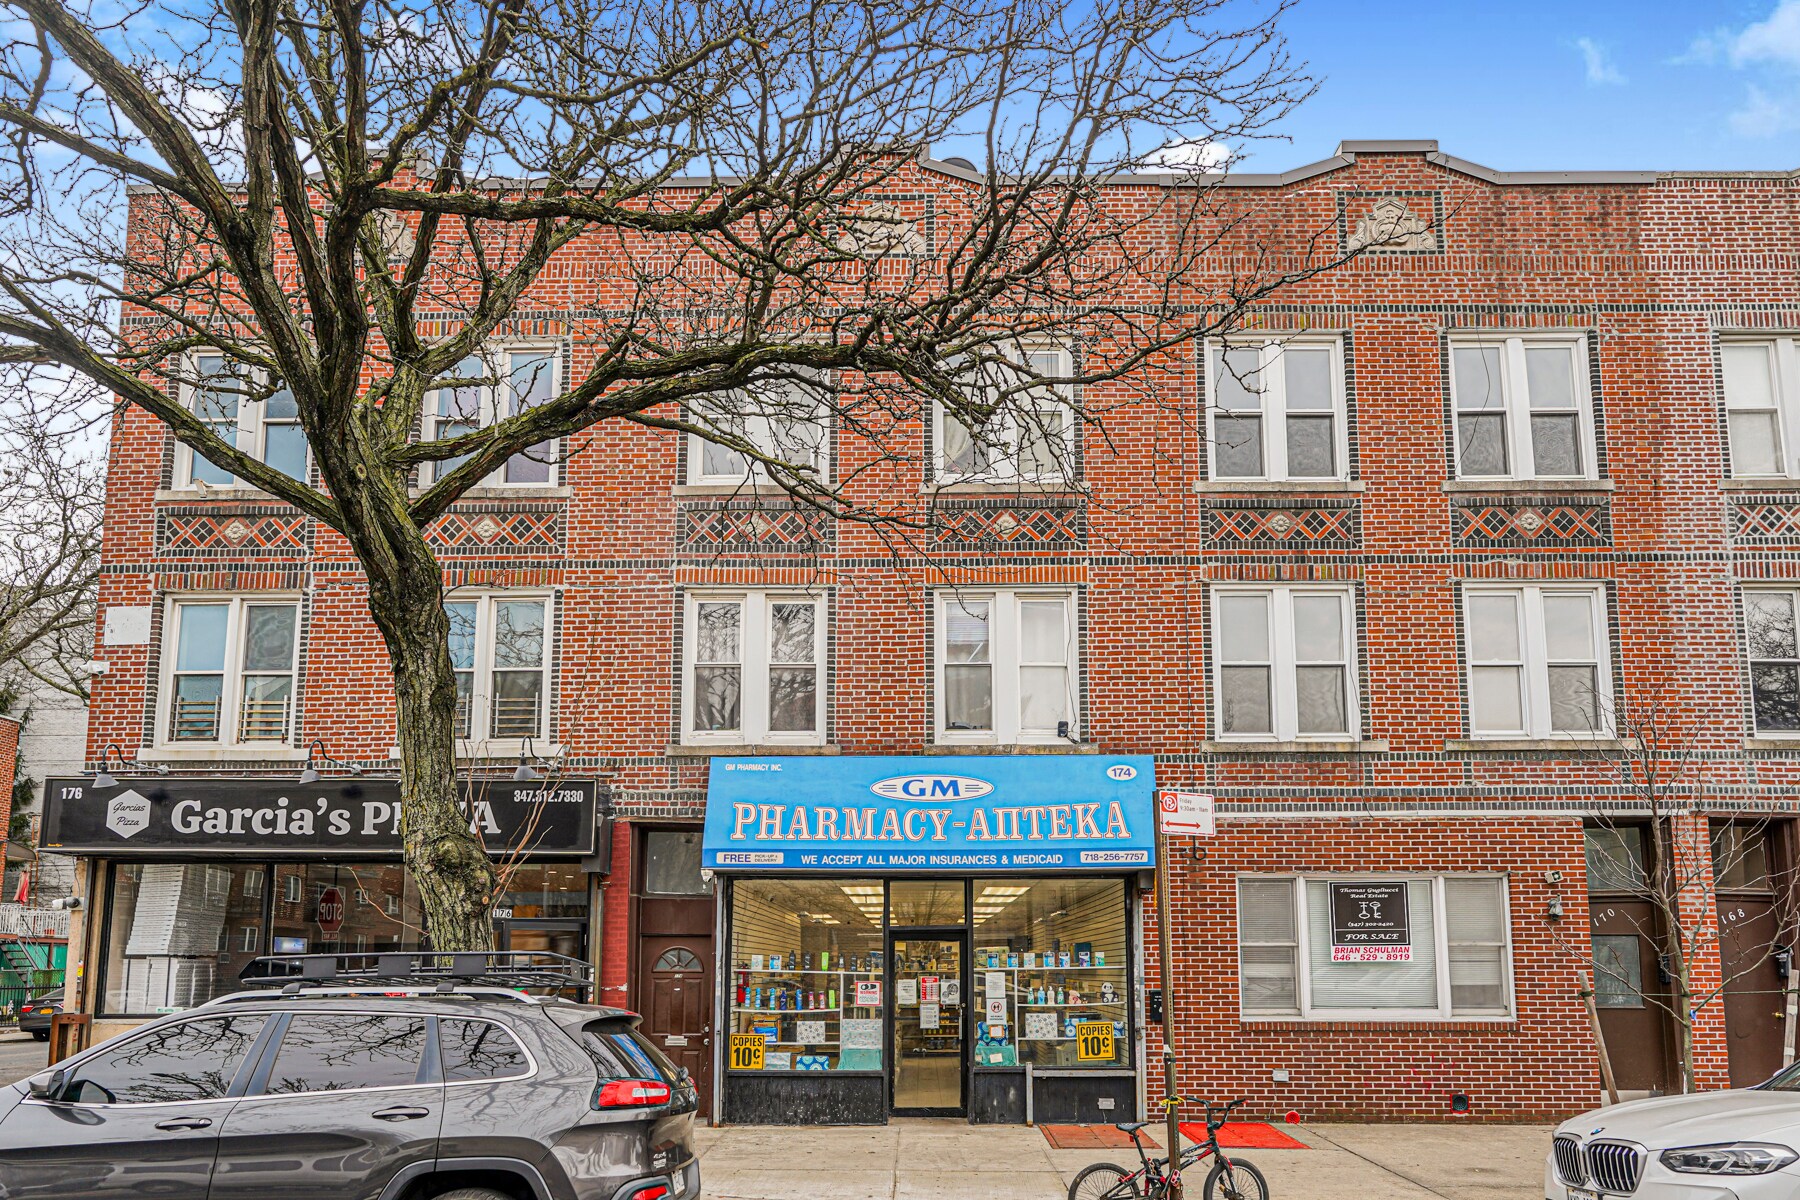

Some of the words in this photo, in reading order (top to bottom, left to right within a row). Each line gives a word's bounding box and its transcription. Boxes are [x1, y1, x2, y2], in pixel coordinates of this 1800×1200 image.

[725, 763, 736, 771] GM
[737, 763, 770, 771] PHARMACY
[771, 763, 783, 772] INC.
[1111, 767, 1132, 778] 174
[901, 779, 961, 797] GM
[61, 787, 83, 800] 176
[1179, 797, 1192, 805] Friday
[113, 801, 146, 813] Garcias
[116, 816, 140, 826] Pizza
[170, 796, 351, 836] Garcia's
[723, 853, 752, 863] FREE
[801, 855, 818, 865] WE
[821, 855, 863, 865] ACCEPT
[866, 855, 886, 865] ALL
[889, 855, 926, 865] MAJOR
[929, 855, 997, 865] INSURANCES
[1001, 855, 1009, 865] &
[1013, 854, 1063, 864] MEDICAID
[1084, 853, 1145, 861] 718-256-7757
[494, 909, 512, 918] 176
[1593, 908, 1615, 927] 170
[1721, 908, 1745, 925] 168
[1344, 933, 1369, 941] FOR
[1334, 946, 1360, 954] BRIAN
[1386, 953, 1410, 961] 8919
[1080, 1026, 1110, 1036] COPIES
[733, 1036, 763, 1047] COPIES
